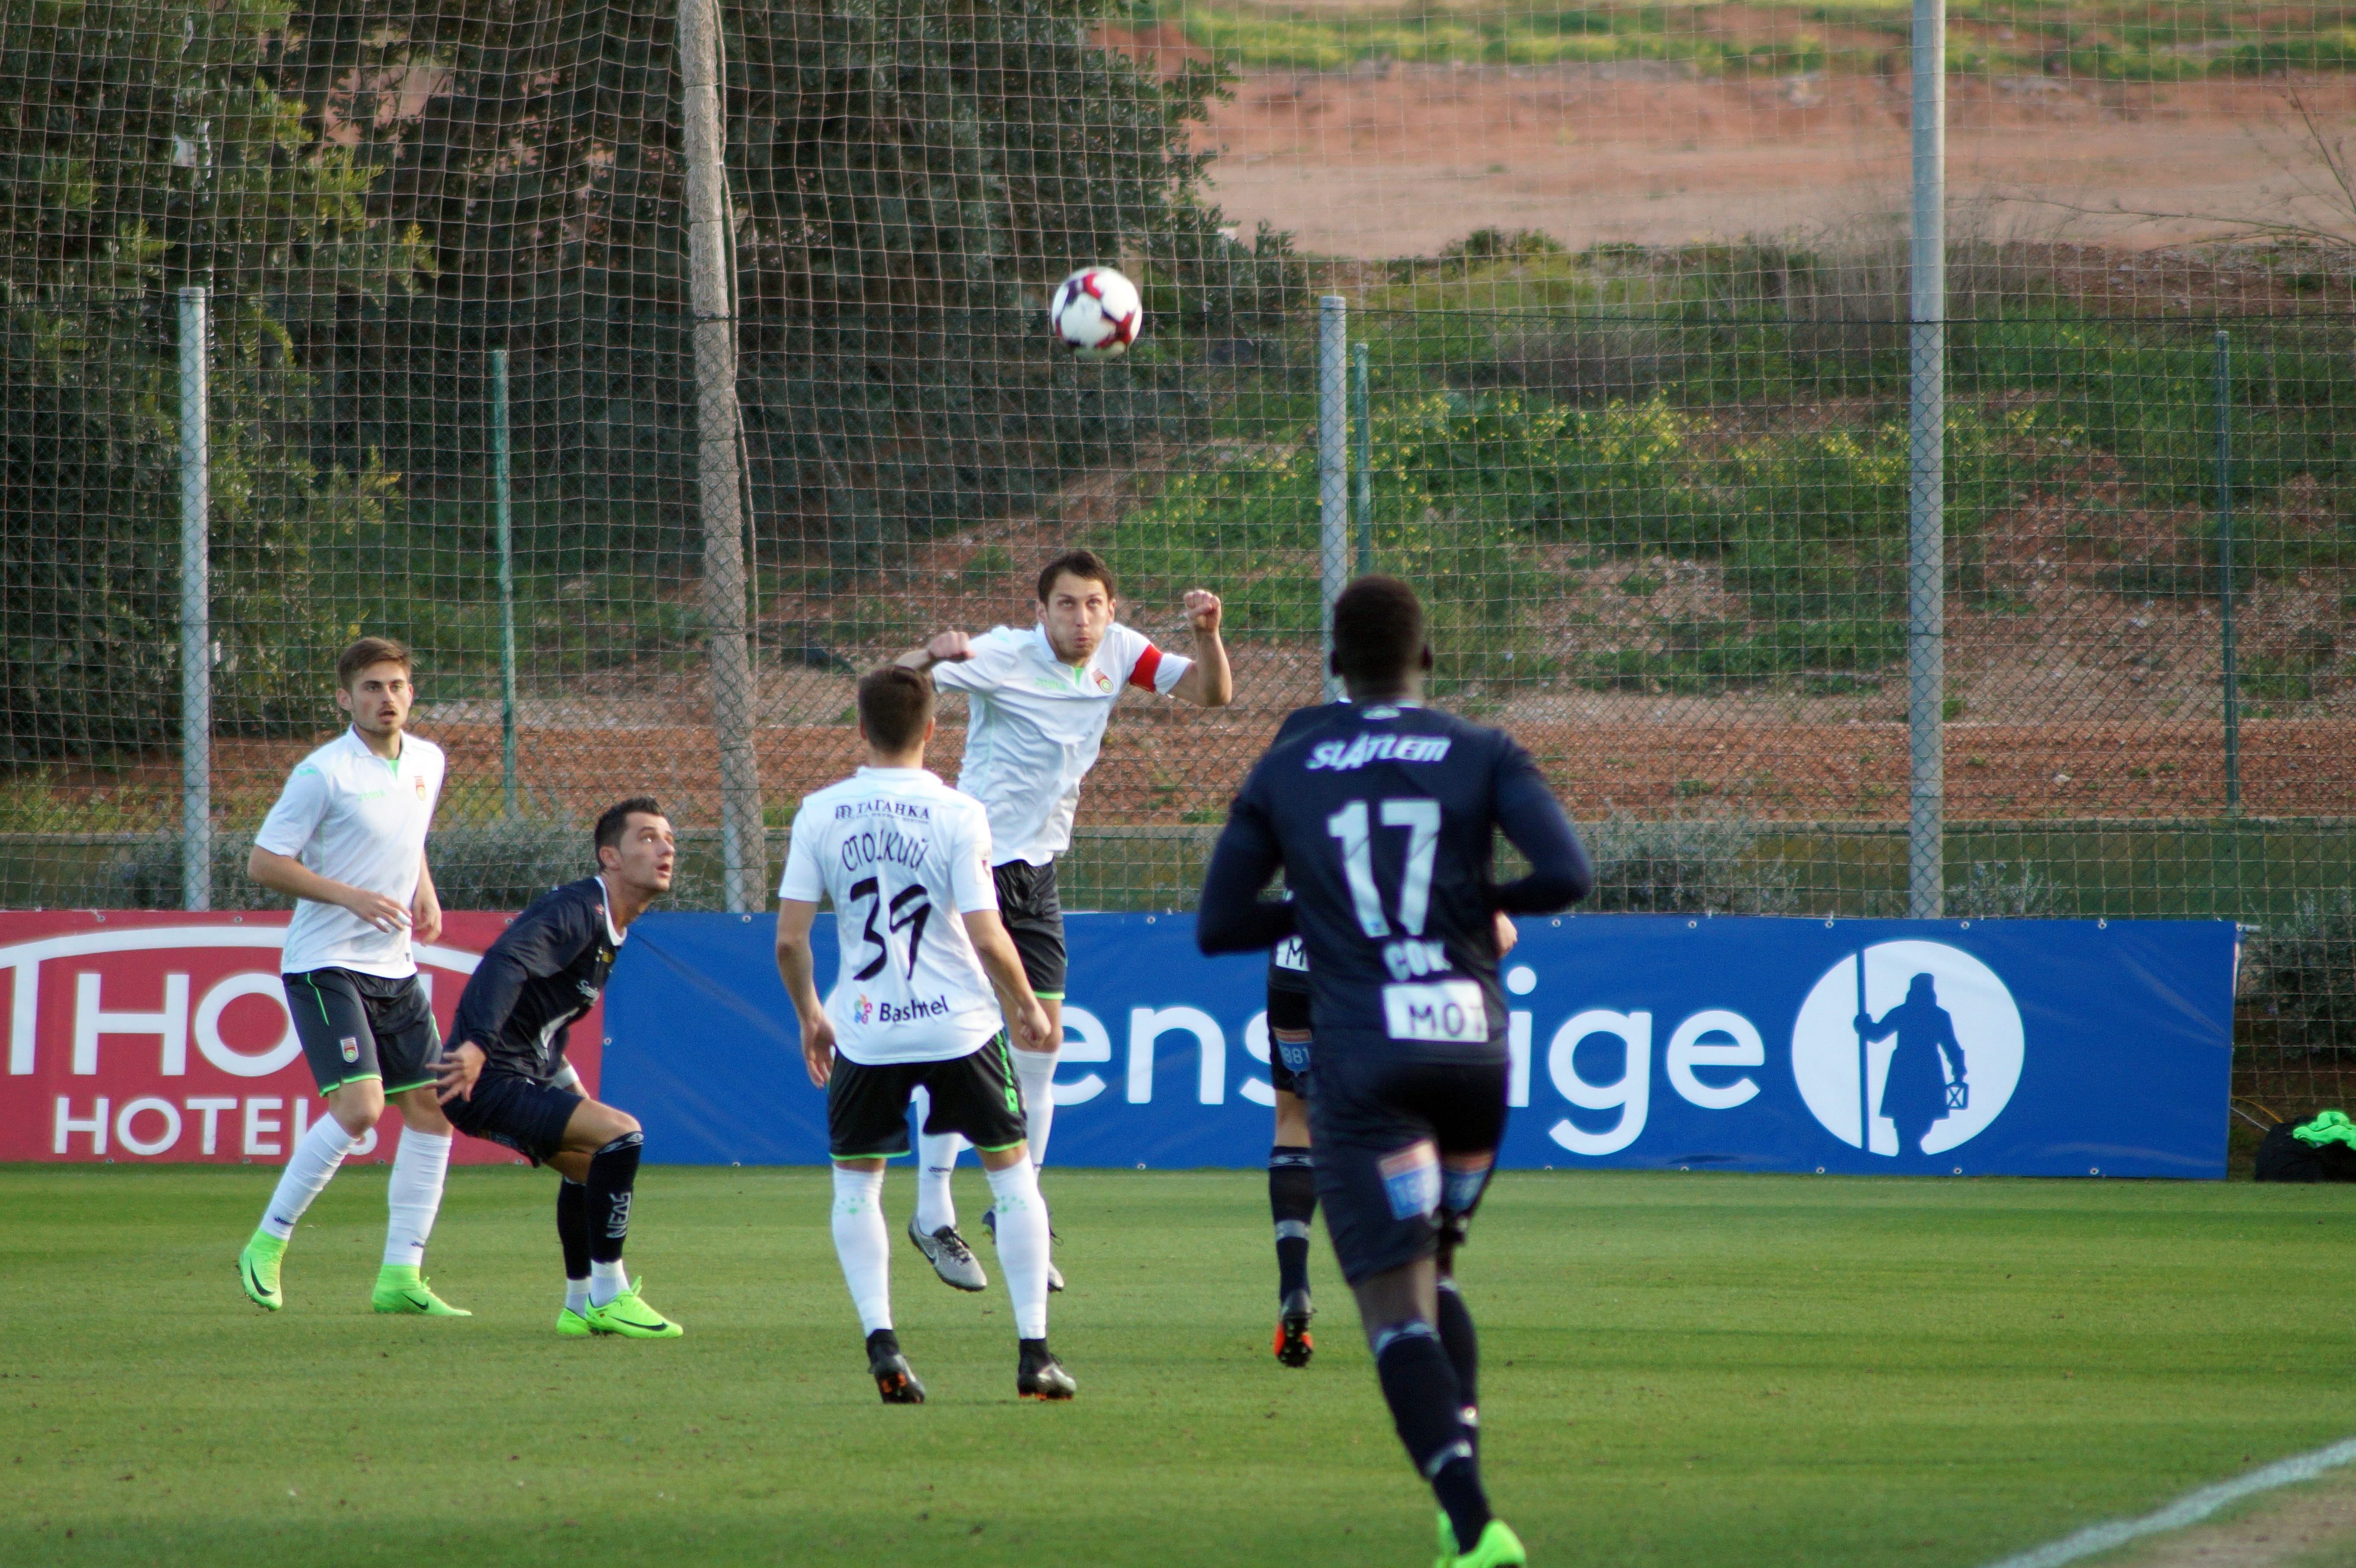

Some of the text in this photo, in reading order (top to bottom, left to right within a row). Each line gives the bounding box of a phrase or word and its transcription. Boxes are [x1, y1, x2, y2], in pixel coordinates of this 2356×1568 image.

[1328, 797, 1441, 938] 17
[850, 876, 932, 981] 39
[879, 995, 949, 1022] Bashtel
